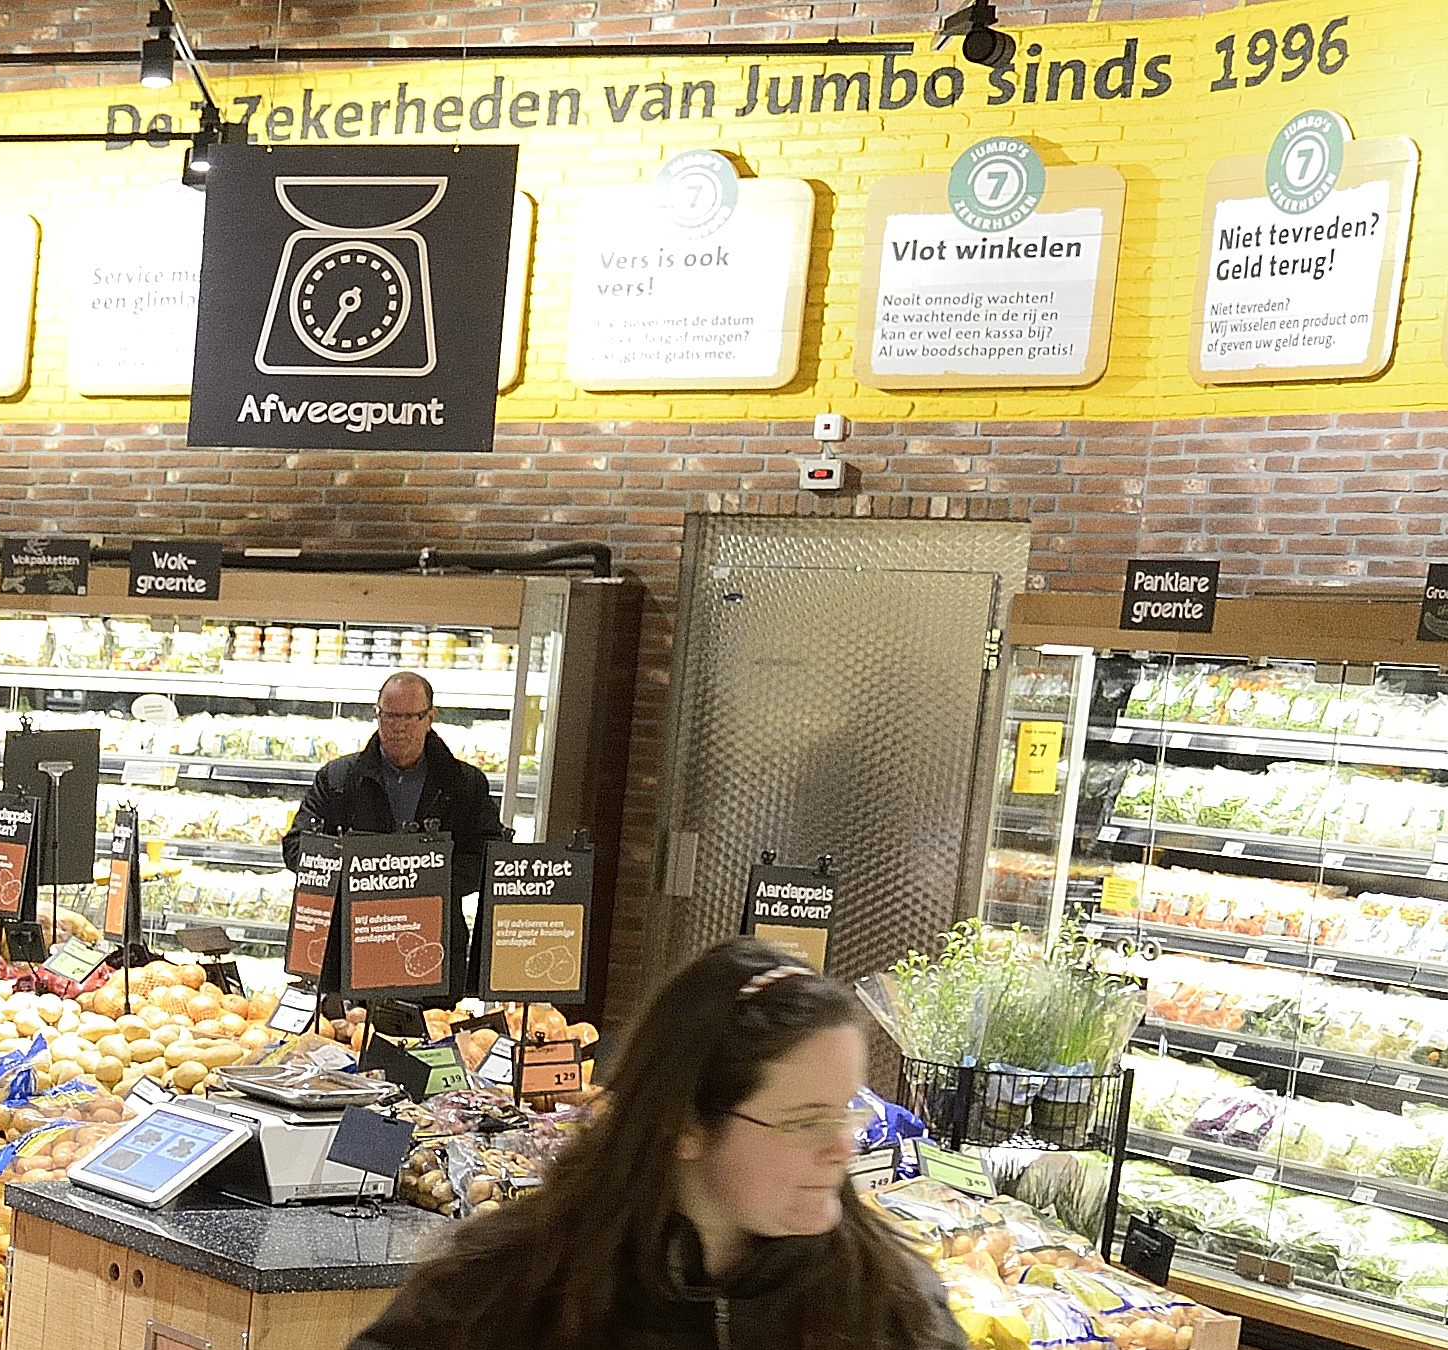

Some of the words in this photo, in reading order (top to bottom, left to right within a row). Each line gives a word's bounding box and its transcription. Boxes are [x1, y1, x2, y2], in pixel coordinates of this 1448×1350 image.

[105, 104, 171, 151] De
[232, 76, 581, 145] Zekerheden
[605, 74, 714, 125] van
[734, 53, 964, 119] Jumbo
[986, 37, 1173, 107] sinds
[1208, 16, 1350, 93] 1996
[1283, 116, 1332, 140] JUMBO'S
[971, 141, 1030, 163] JUMBO'S
[1297, 148, 1314, 181] 7
[987, 171, 1009, 200] 7
[1269, 172, 1336, 213] ZEKERHEDEN
[687, 185, 703, 208] 7
[953, 194, 1037, 231] ZEKERHEDEN
[1219, 225, 1262, 251] Niet
[1269, 212, 1380, 245] tevreden?
[601, 251, 649, 269] Vers
[659, 248, 674, 267] is
[684, 246, 730, 267] ook
[893, 239, 946, 262] Vlot
[956, 236, 1082, 260] winkelen
[1216, 254, 1262, 281] Geld
[1269, 248, 1336, 281] terug!
[93, 265, 164, 286] Service
[597, 276, 654, 297] vers!
[92, 294, 125, 310] een
[883, 294, 921, 307] Nooit
[925, 293, 983, 308] onnodig
[987, 291, 1055, 305] wachten!
[1210, 303, 1233, 317] Niet
[1236, 298, 1290, 315] tevreden?
[692, 315, 707, 327] de
[711, 315, 754, 326] datum
[882, 312, 900, 323] 4e
[904, 310, 980, 323] wachtende
[984, 309, 997, 322] in
[1001, 309, 1019, 322] de
[1023, 309, 1037, 325] rij
[1041, 311, 1058, 321] en
[1210, 321, 1228, 336] Wij
[1230, 320, 1277, 333] wisselen
[1279, 318, 1300, 330] een
[1302, 313, 1351, 332] product
[1351, 312, 1368, 324] om
[692, 330, 751, 346] morgen?
[880, 328, 905, 340] kan
[909, 330, 925, 340] er
[927, 327, 952, 340] wel
[955, 328, 981, 339] een
[985, 326, 1023, 339] kassa
[1028, 325, 1053, 341] bij?
[879, 344, 893, 358] Al
[896, 346, 918, 357] uw
[921, 342, 1024, 360] boodschappen
[1028, 342, 1074, 359] gratis!
[1207, 339, 1219, 353] of
[1220, 341, 1252, 355] geven
[1255, 339, 1272, 349] uw
[1274, 334, 1299, 352] geld
[1302, 334, 1336, 349] terug.
[664, 350, 700, 364] gratis
[704, 350, 737, 360] mee.
[237, 393, 445, 432] Afweegpunt
[152, 551, 197, 571] Wok-
[136, 575, 207, 594] groente
[1133, 571, 1210, 594] Panklare
[1131, 597, 1204, 623] groente
[1029, 744, 1047, 757] 27
[349, 852, 444, 873] Aardappels
[494, 860, 528, 877] Zelf
[532, 860, 572, 876] friet
[349, 873, 417, 892] bakken?
[493, 879, 555, 896] maken?
[756, 881, 833, 904] Aardappels
[771, 901, 789, 917] de
[791, 905, 832, 919] oven?
